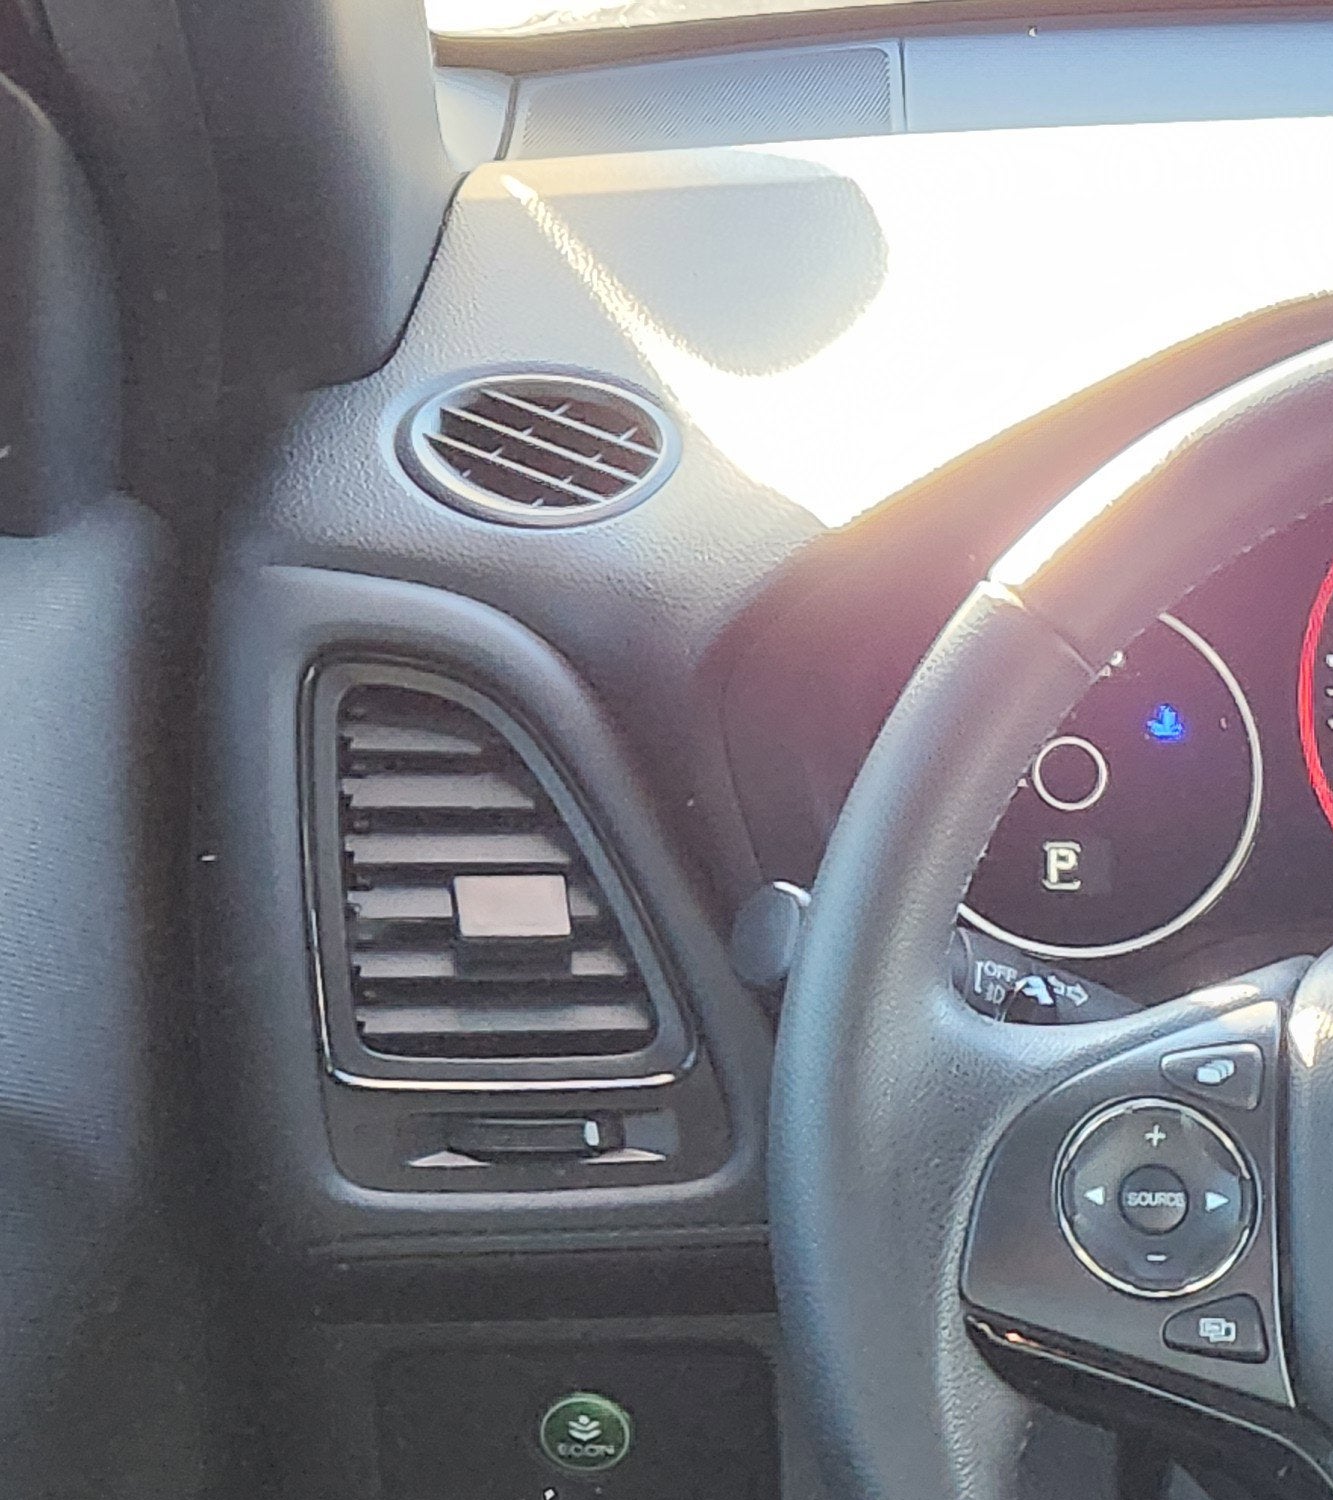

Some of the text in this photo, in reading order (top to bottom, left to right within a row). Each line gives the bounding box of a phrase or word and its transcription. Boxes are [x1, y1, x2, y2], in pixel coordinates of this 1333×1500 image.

[1048, 847, 1078, 884] P
[983, 960, 1018, 982] OFF
[1126, 1191, 1186, 1208] SOURCE
